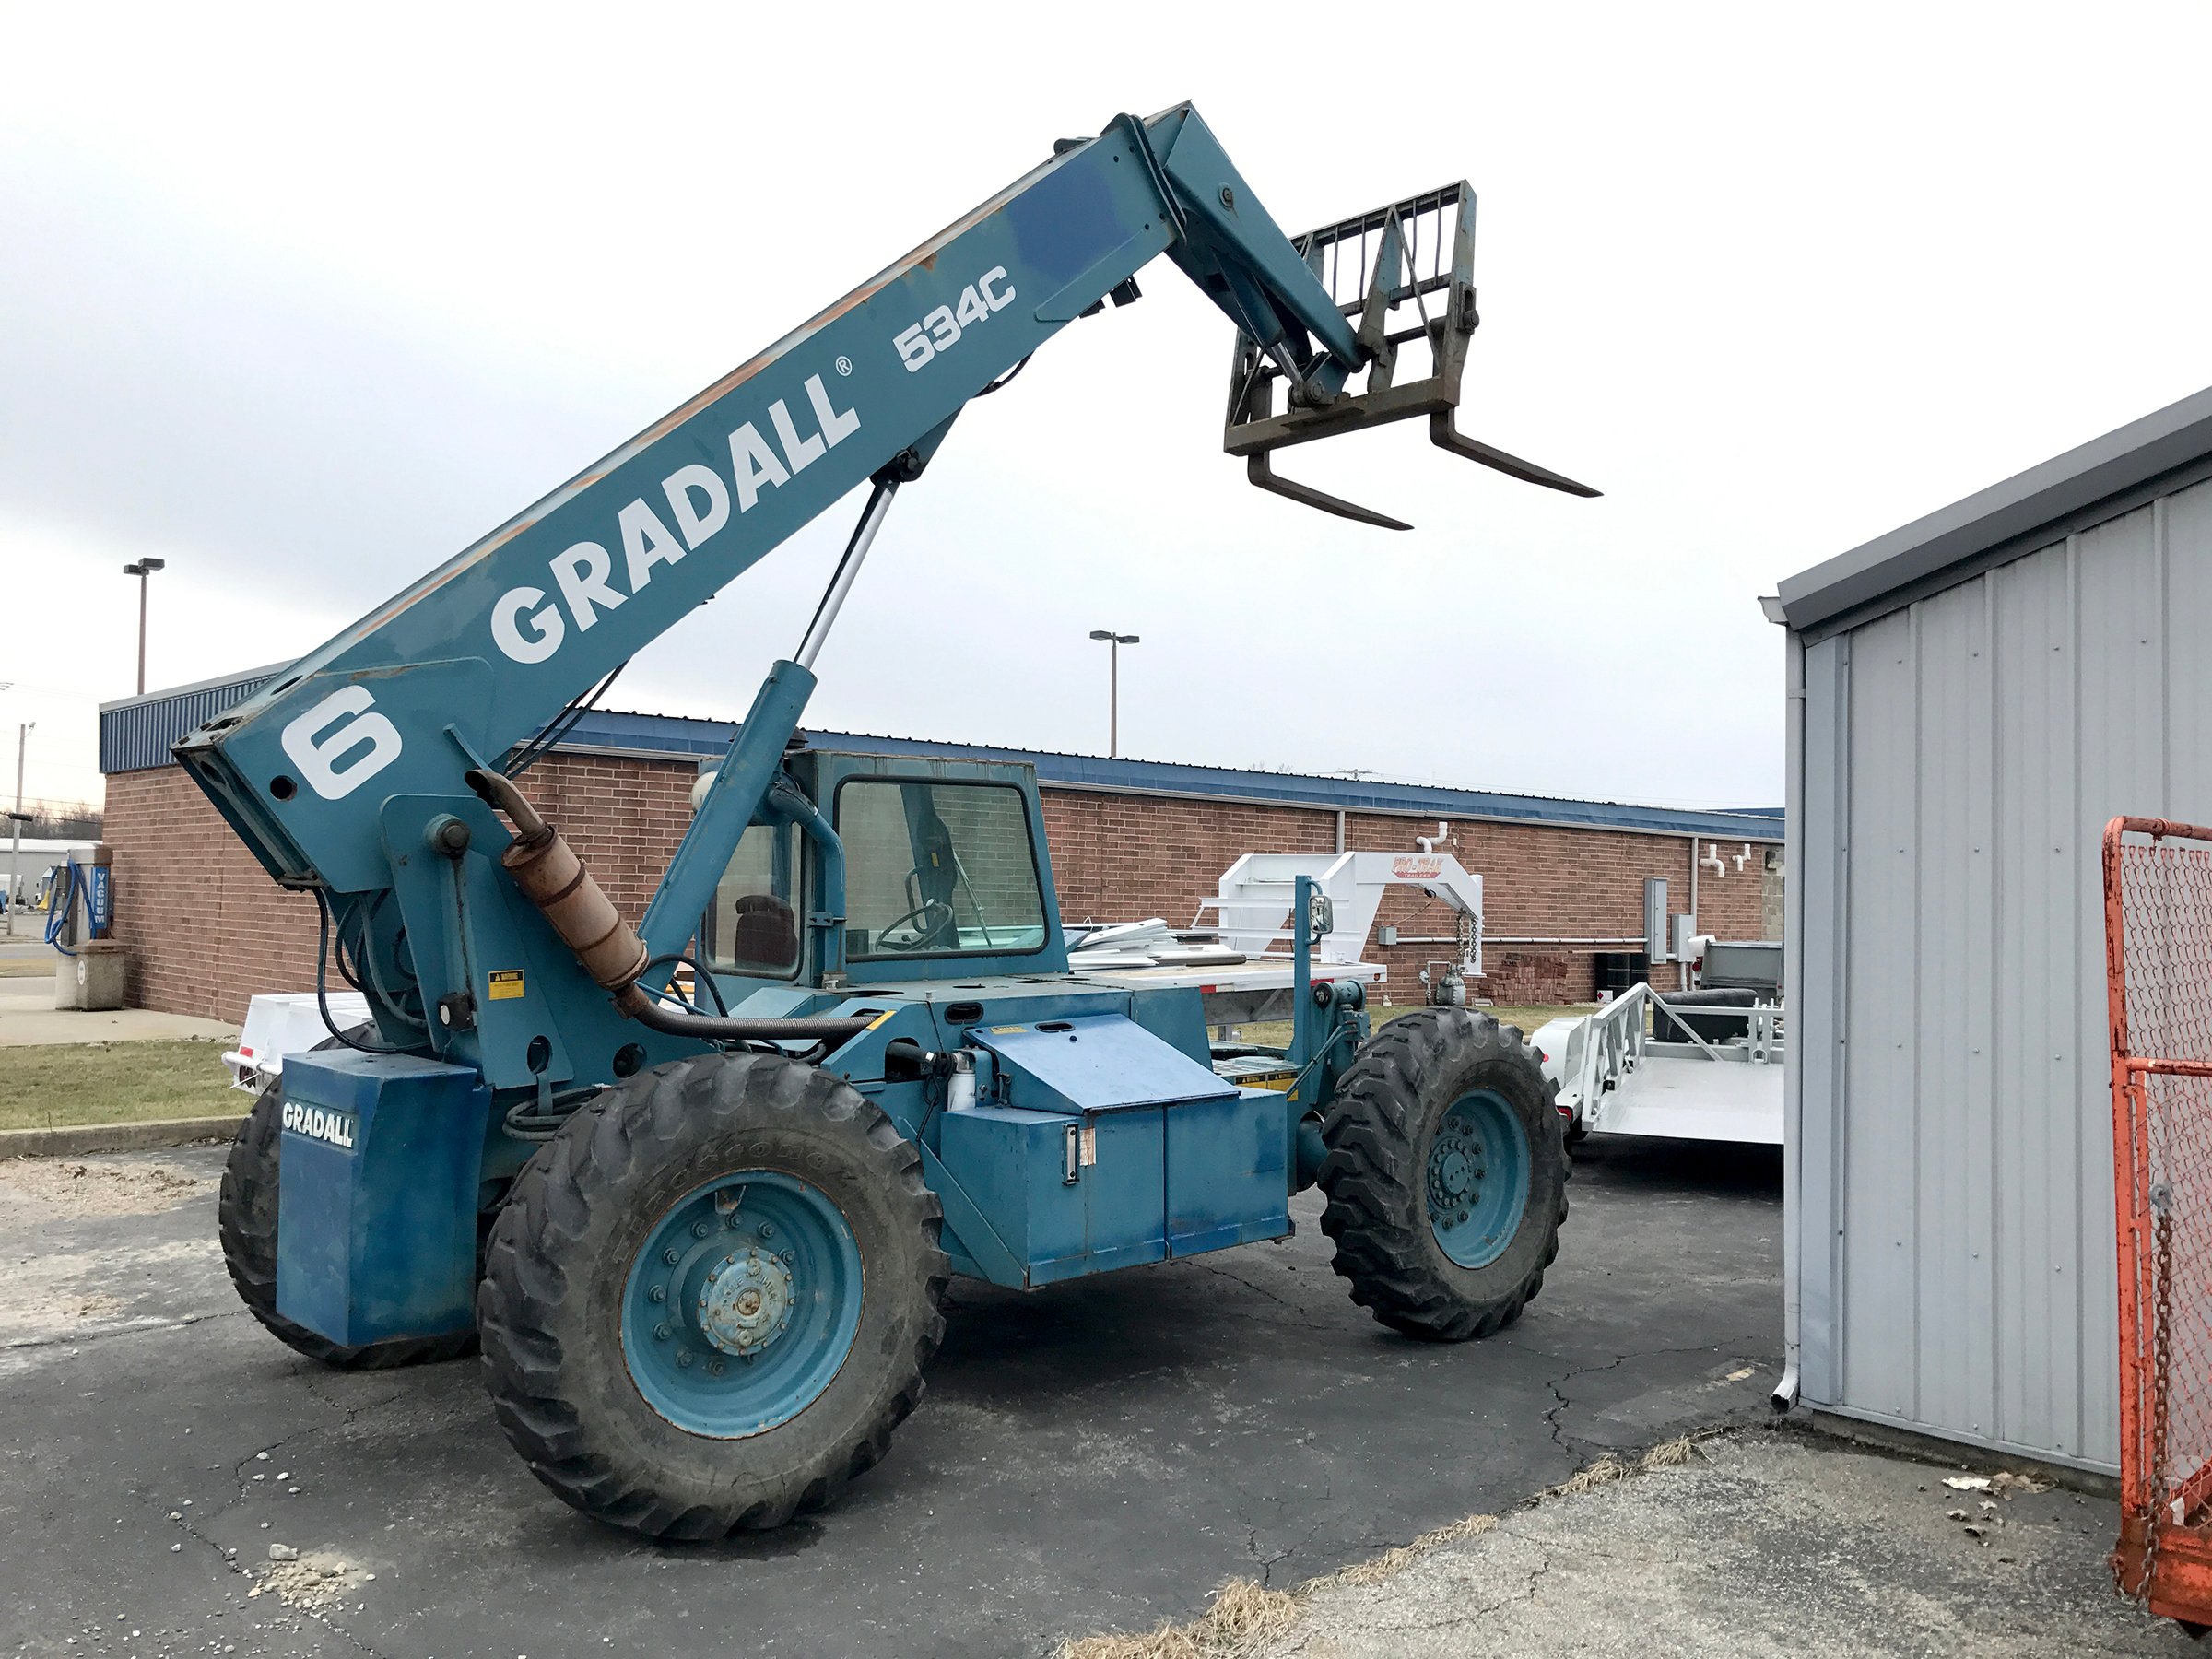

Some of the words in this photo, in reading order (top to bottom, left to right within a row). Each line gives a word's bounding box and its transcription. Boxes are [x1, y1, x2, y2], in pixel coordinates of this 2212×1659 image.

[490, 372, 862, 665] GRADALL
[892, 265, 1017, 372] 534C
[281, 685, 403, 800] 6
[94, 872, 106, 923] VACUUM
[283, 1101, 353, 1147] GRADALL
